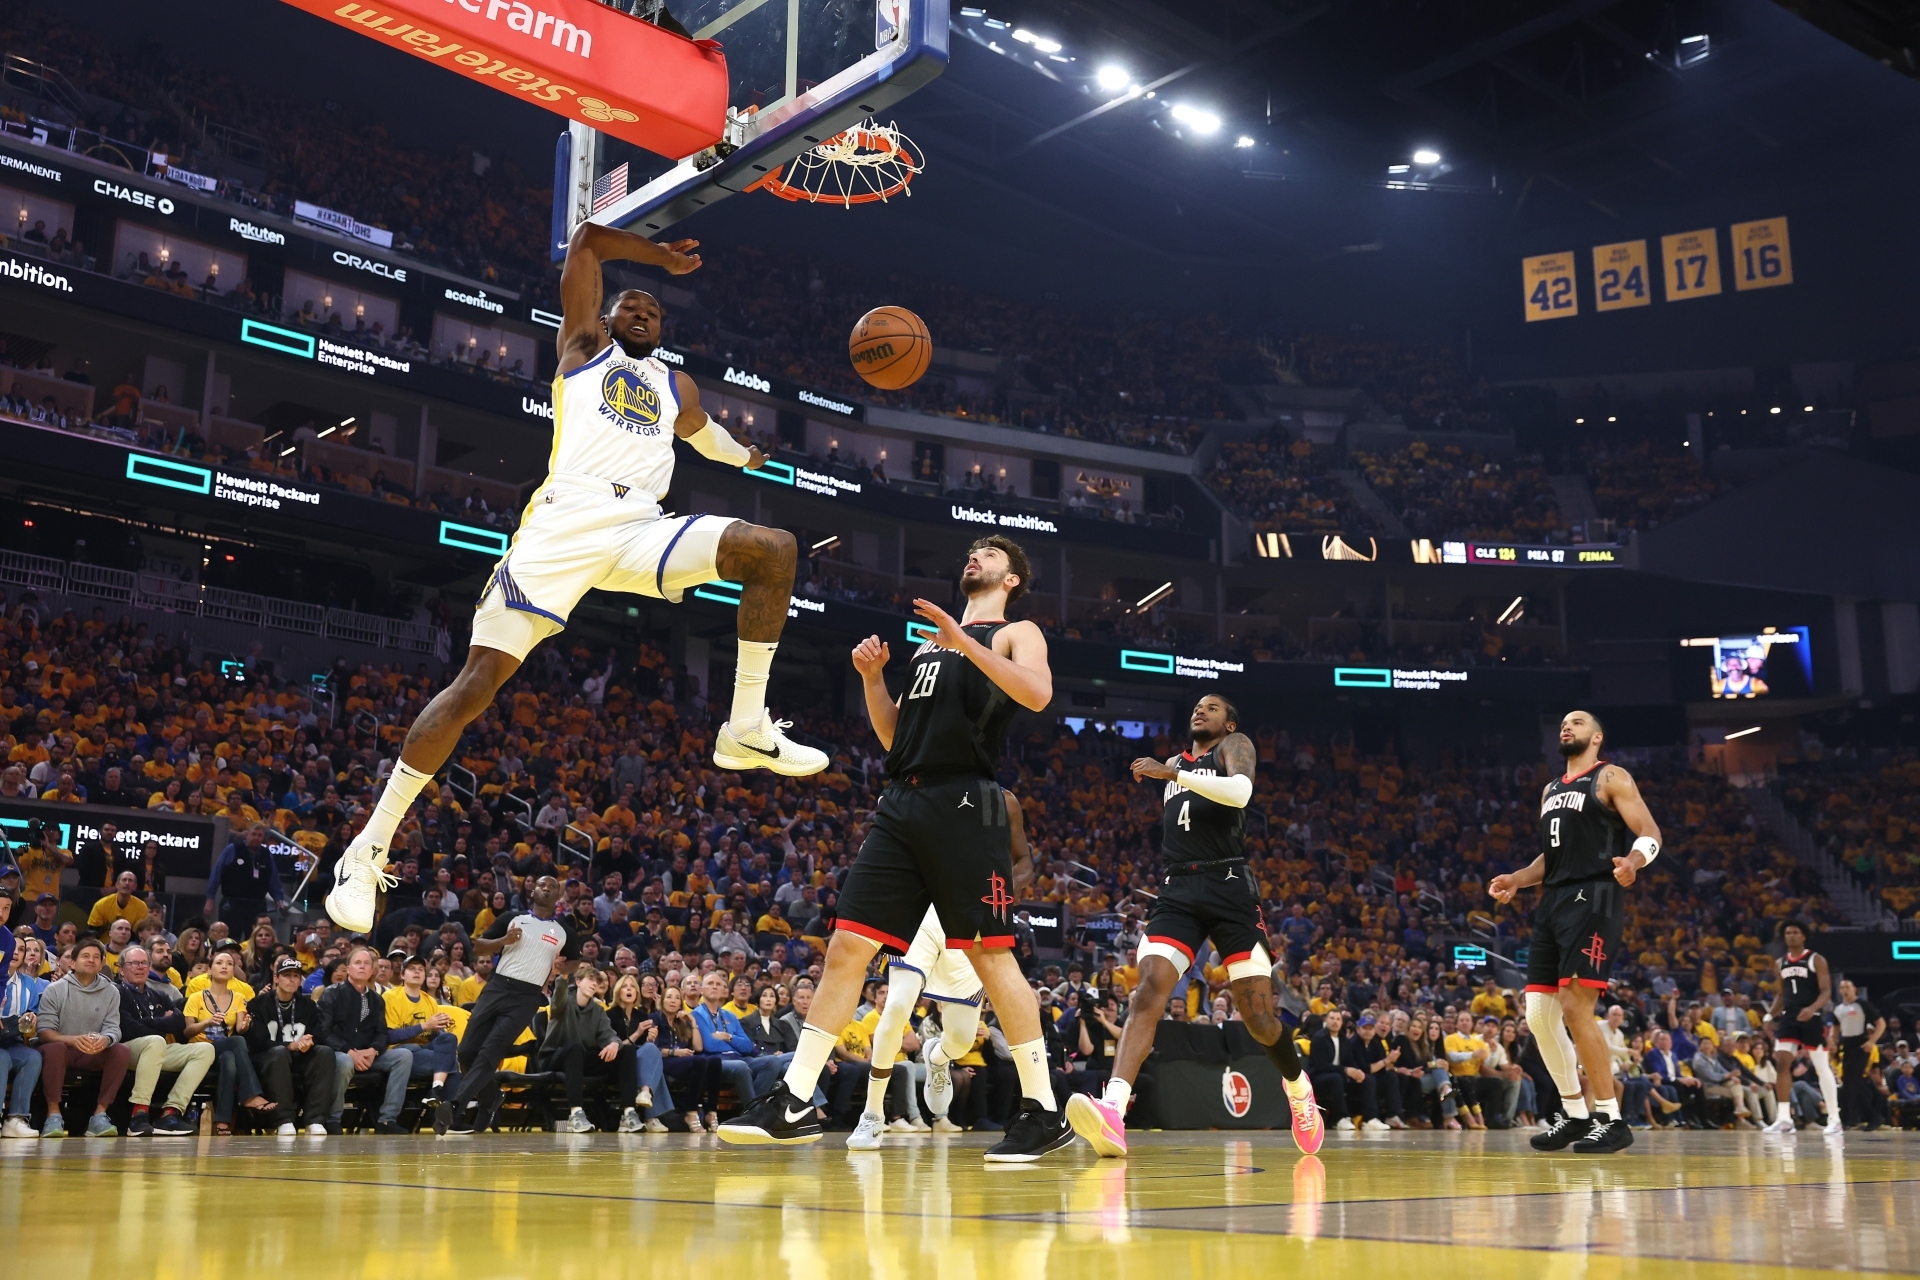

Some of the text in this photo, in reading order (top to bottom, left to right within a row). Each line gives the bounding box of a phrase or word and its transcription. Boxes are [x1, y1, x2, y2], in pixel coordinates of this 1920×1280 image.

[94, 179, 156, 209] CHASE
[229, 217, 285, 246] Rakuten
[333, 251, 407, 283] ORACLE
[1675, 254, 1708, 291] 17
[1743, 244, 1782, 281] 16
[1530, 277, 1573, 311] 42
[1600, 265, 1645, 302] 24
[445, 288, 504, 314] accenture
[317, 350, 376, 376] Enterprise
[319, 339, 410, 373] Hewlett Packard
[605, 359, 639, 373] GOLDEN
[723, 367, 771, 393] Adobe
[636, 385, 655, 406] 00
[799, 389, 854, 415] ticketmaster
[598, 402, 661, 437] WARRIORS
[216, 471, 320, 506] Hewlett Packard
[796, 468, 861, 493] Hewlett Packard
[796, 478, 838, 497] Enterprise
[214, 485, 281, 510] Enterprise
[951, 505, 1058, 533] Unlock ambition.
[1475, 548, 1497, 559] CLE
[1498, 547, 1516, 561] 124
[1527, 550, 1549, 561] MIA
[1578, 551, 1615, 562] FINAL
[790, 595, 825, 612] Packard
[908, 661, 941, 699] 28
[1164, 768, 1217, 807] HOUON
[1177, 800, 1191, 832] 4
[1540, 791, 1586, 819] HOUSTON
[76, 824, 138, 844] Heett
[1550, 817, 1561, 848] 9
[1791, 979, 1798, 994] 1
